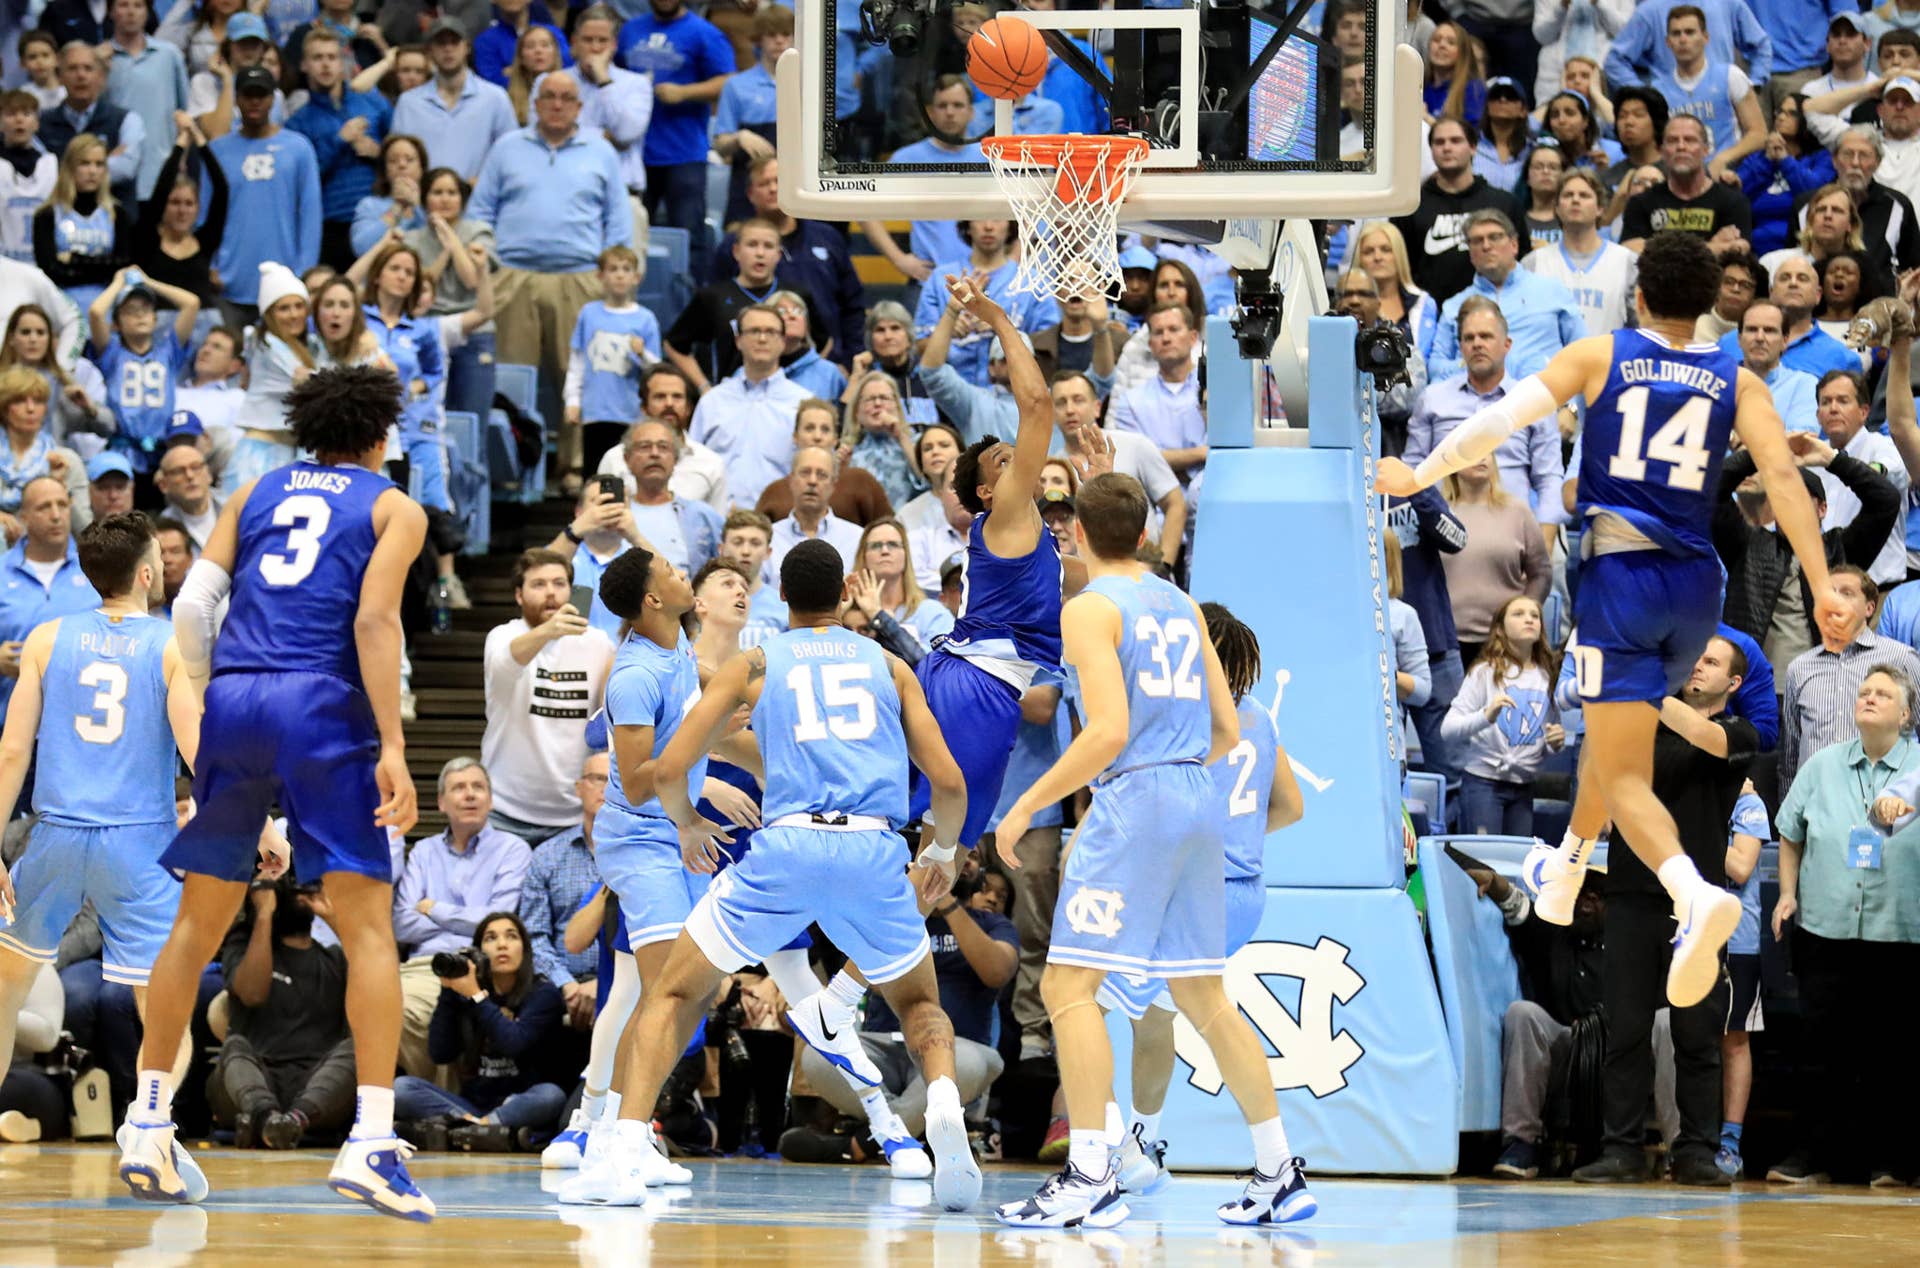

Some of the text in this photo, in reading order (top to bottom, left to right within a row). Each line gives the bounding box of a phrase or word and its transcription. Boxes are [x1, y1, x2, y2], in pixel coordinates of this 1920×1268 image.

[818, 179, 876, 192] SPALDING
[121, 360, 166, 408] 89
[1620, 358, 1728, 401] GOLDWIRE
[1609, 385, 1713, 492] 14
[283, 470, 352, 495] JONES
[258, 494, 332, 586] 3
[791, 641, 858, 660] BROOKS
[1135, 614, 1201, 700] 32
[75, 660, 128, 744] 3
[786, 662, 879, 742] 15
[1228, 739, 1257, 817] 2
